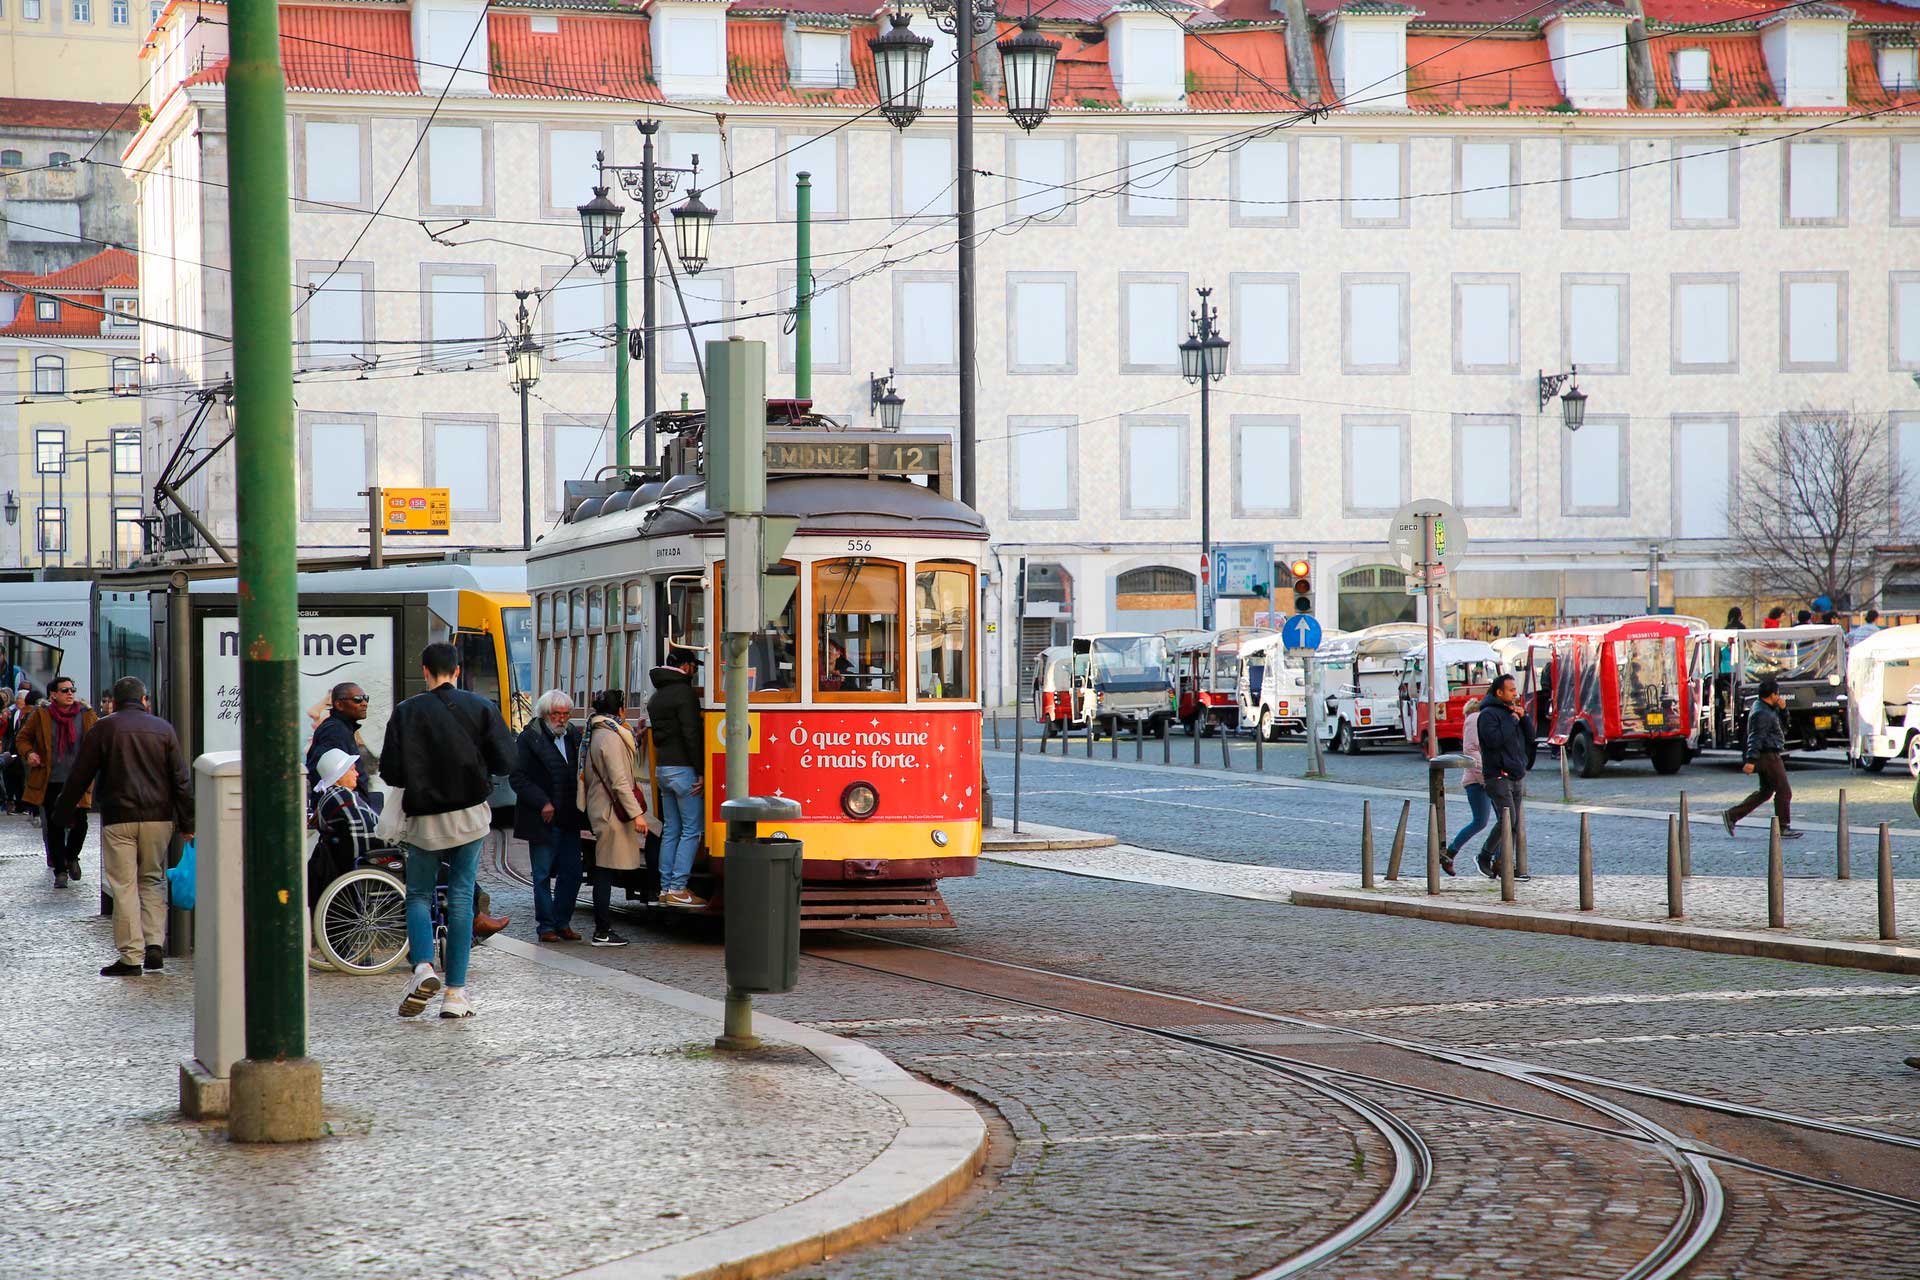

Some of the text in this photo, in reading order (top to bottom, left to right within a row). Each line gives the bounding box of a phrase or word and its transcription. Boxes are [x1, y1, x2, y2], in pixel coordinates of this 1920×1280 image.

[780, 447, 857, 464] MONIZ
[894, 447, 923, 471] 12
[656, 547, 681, 558] ENTRADA
[847, 539, 872, 552] 556
[220, 629, 374, 656] mmer
[217, 685, 225, 696] A
[217, 708, 231, 720] de
[790, 726, 929, 750] O que nos une
[800, 748, 920, 768] é mais forte.
